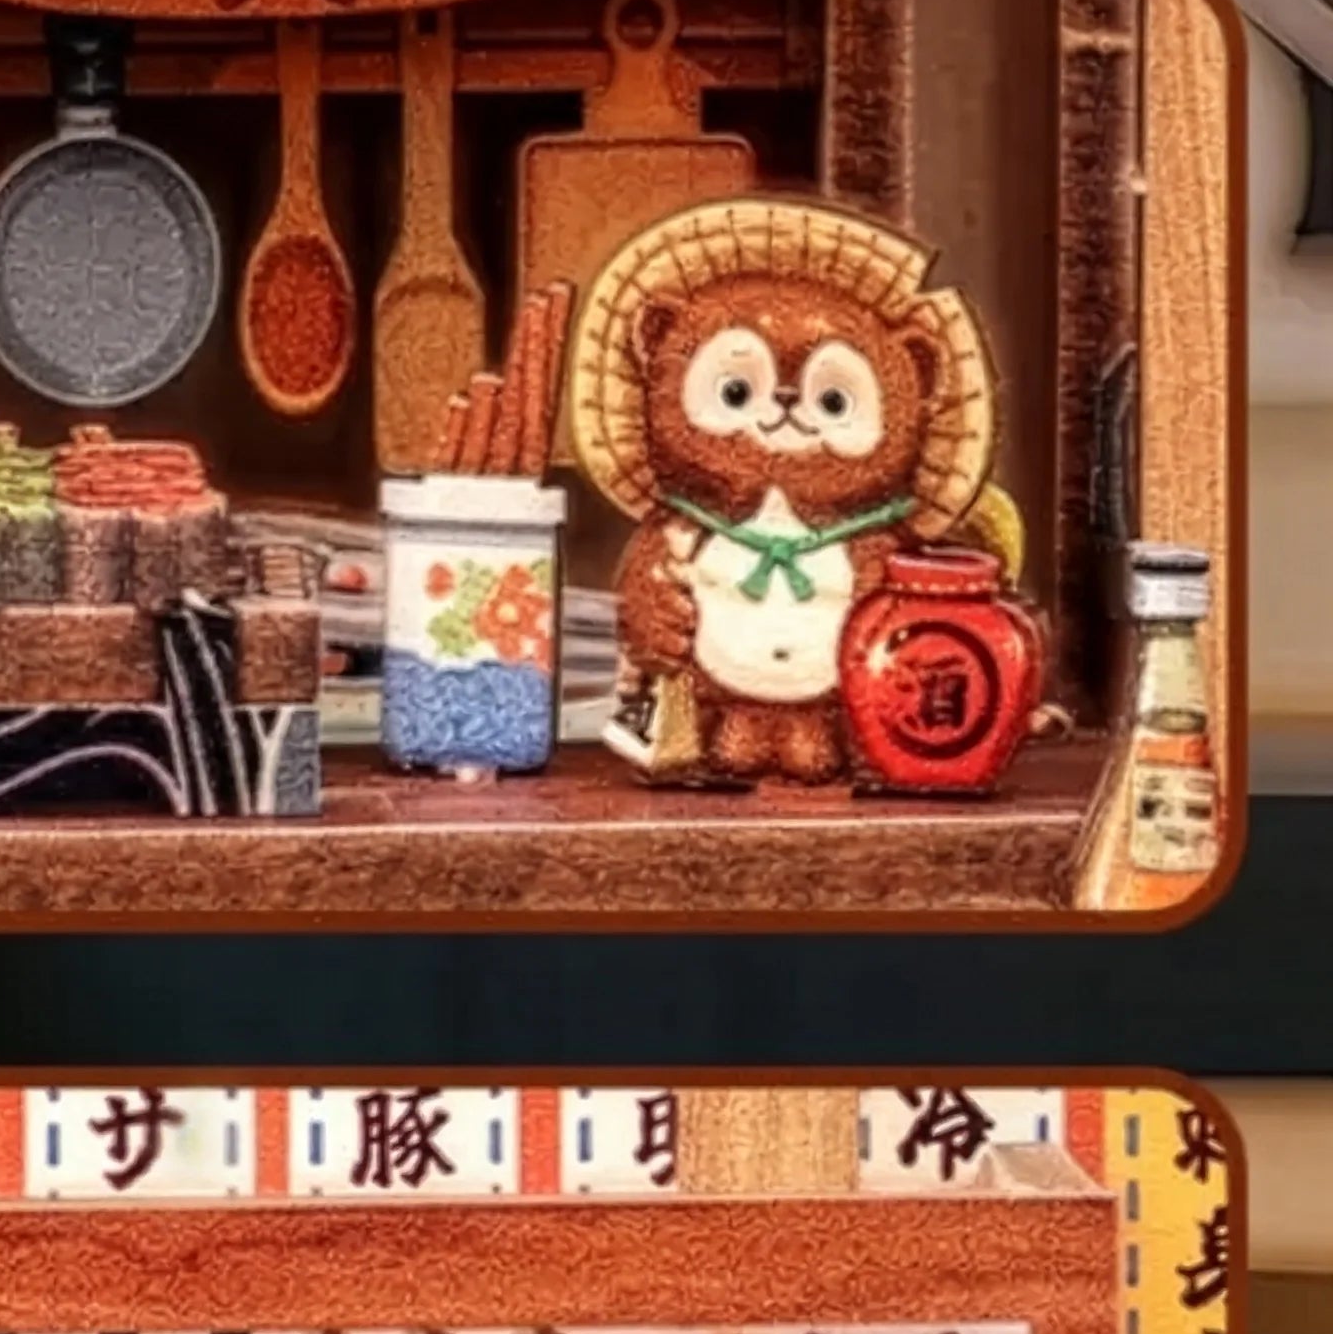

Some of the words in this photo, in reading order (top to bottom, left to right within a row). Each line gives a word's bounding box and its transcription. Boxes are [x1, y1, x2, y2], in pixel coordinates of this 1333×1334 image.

[88, 1092, 185, 1190] サ
[349, 1089, 455, 1187] 豚
[896, 1087, 995, 1182] 冷
